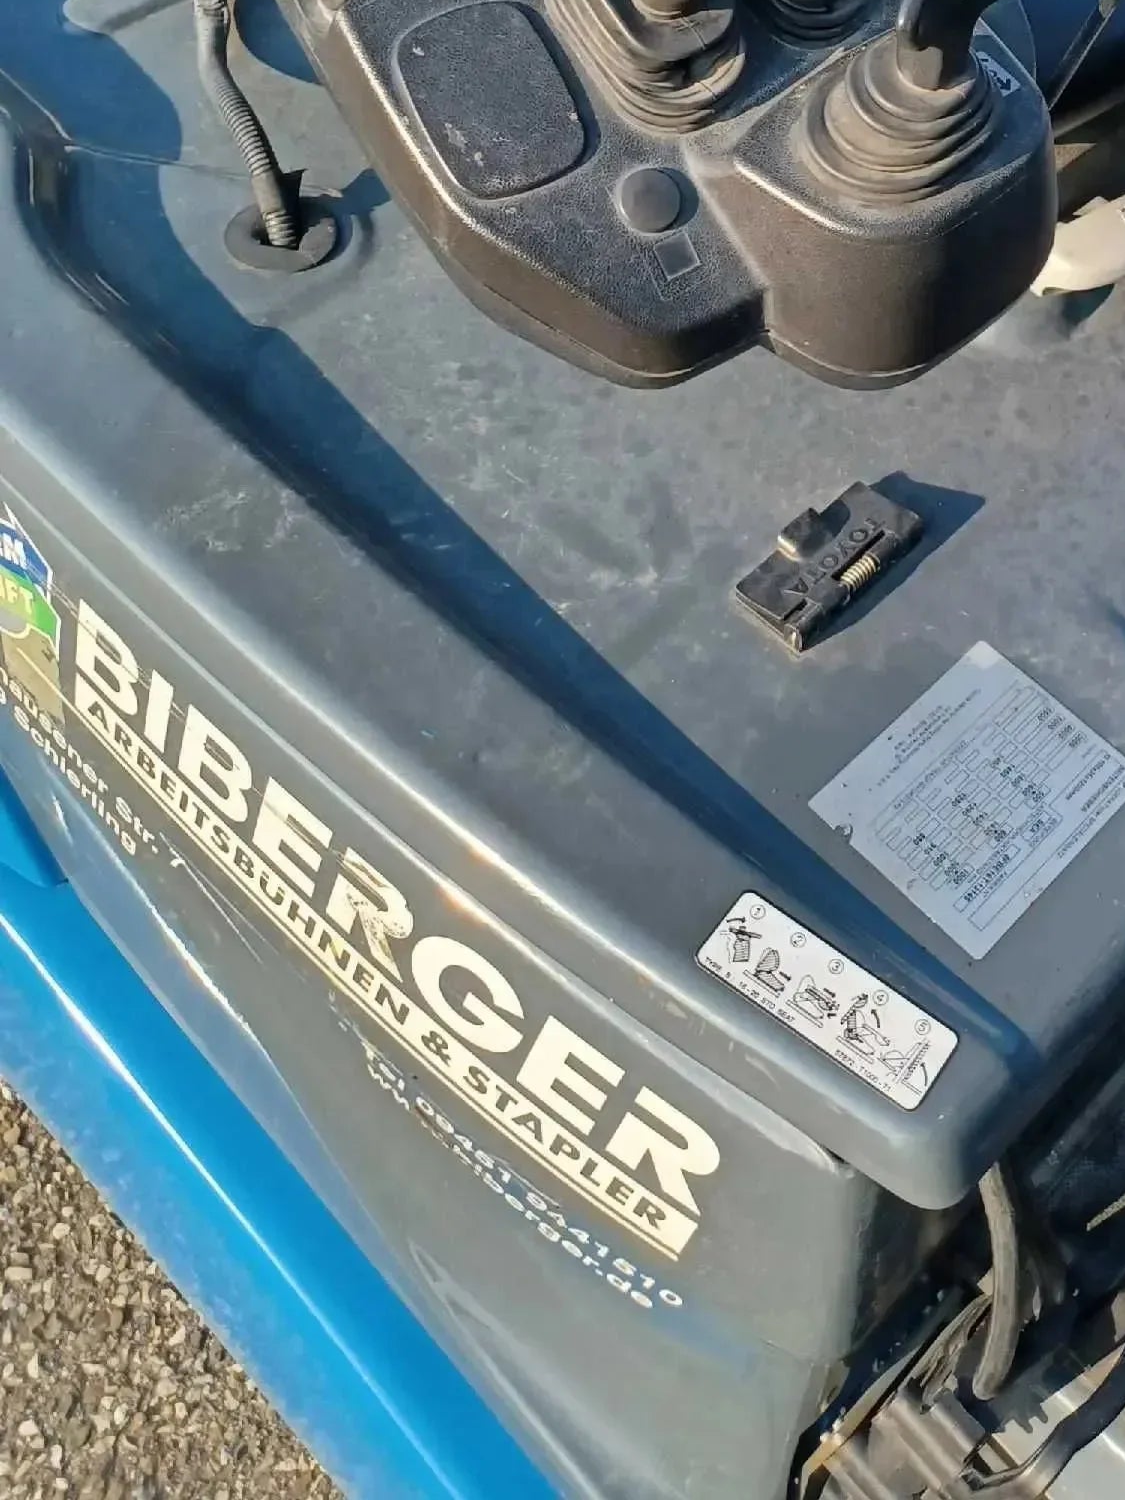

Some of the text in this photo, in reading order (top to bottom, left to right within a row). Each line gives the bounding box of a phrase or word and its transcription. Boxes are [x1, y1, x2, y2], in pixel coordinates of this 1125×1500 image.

[784, 516, 887, 595] TOYOTA
[75, 599, 720, 1217] BIBERGER
[88, 701, 668, 1230] ARBEITSBÜHNEN & STAPLER
[115, 796, 159, 854] Str.
